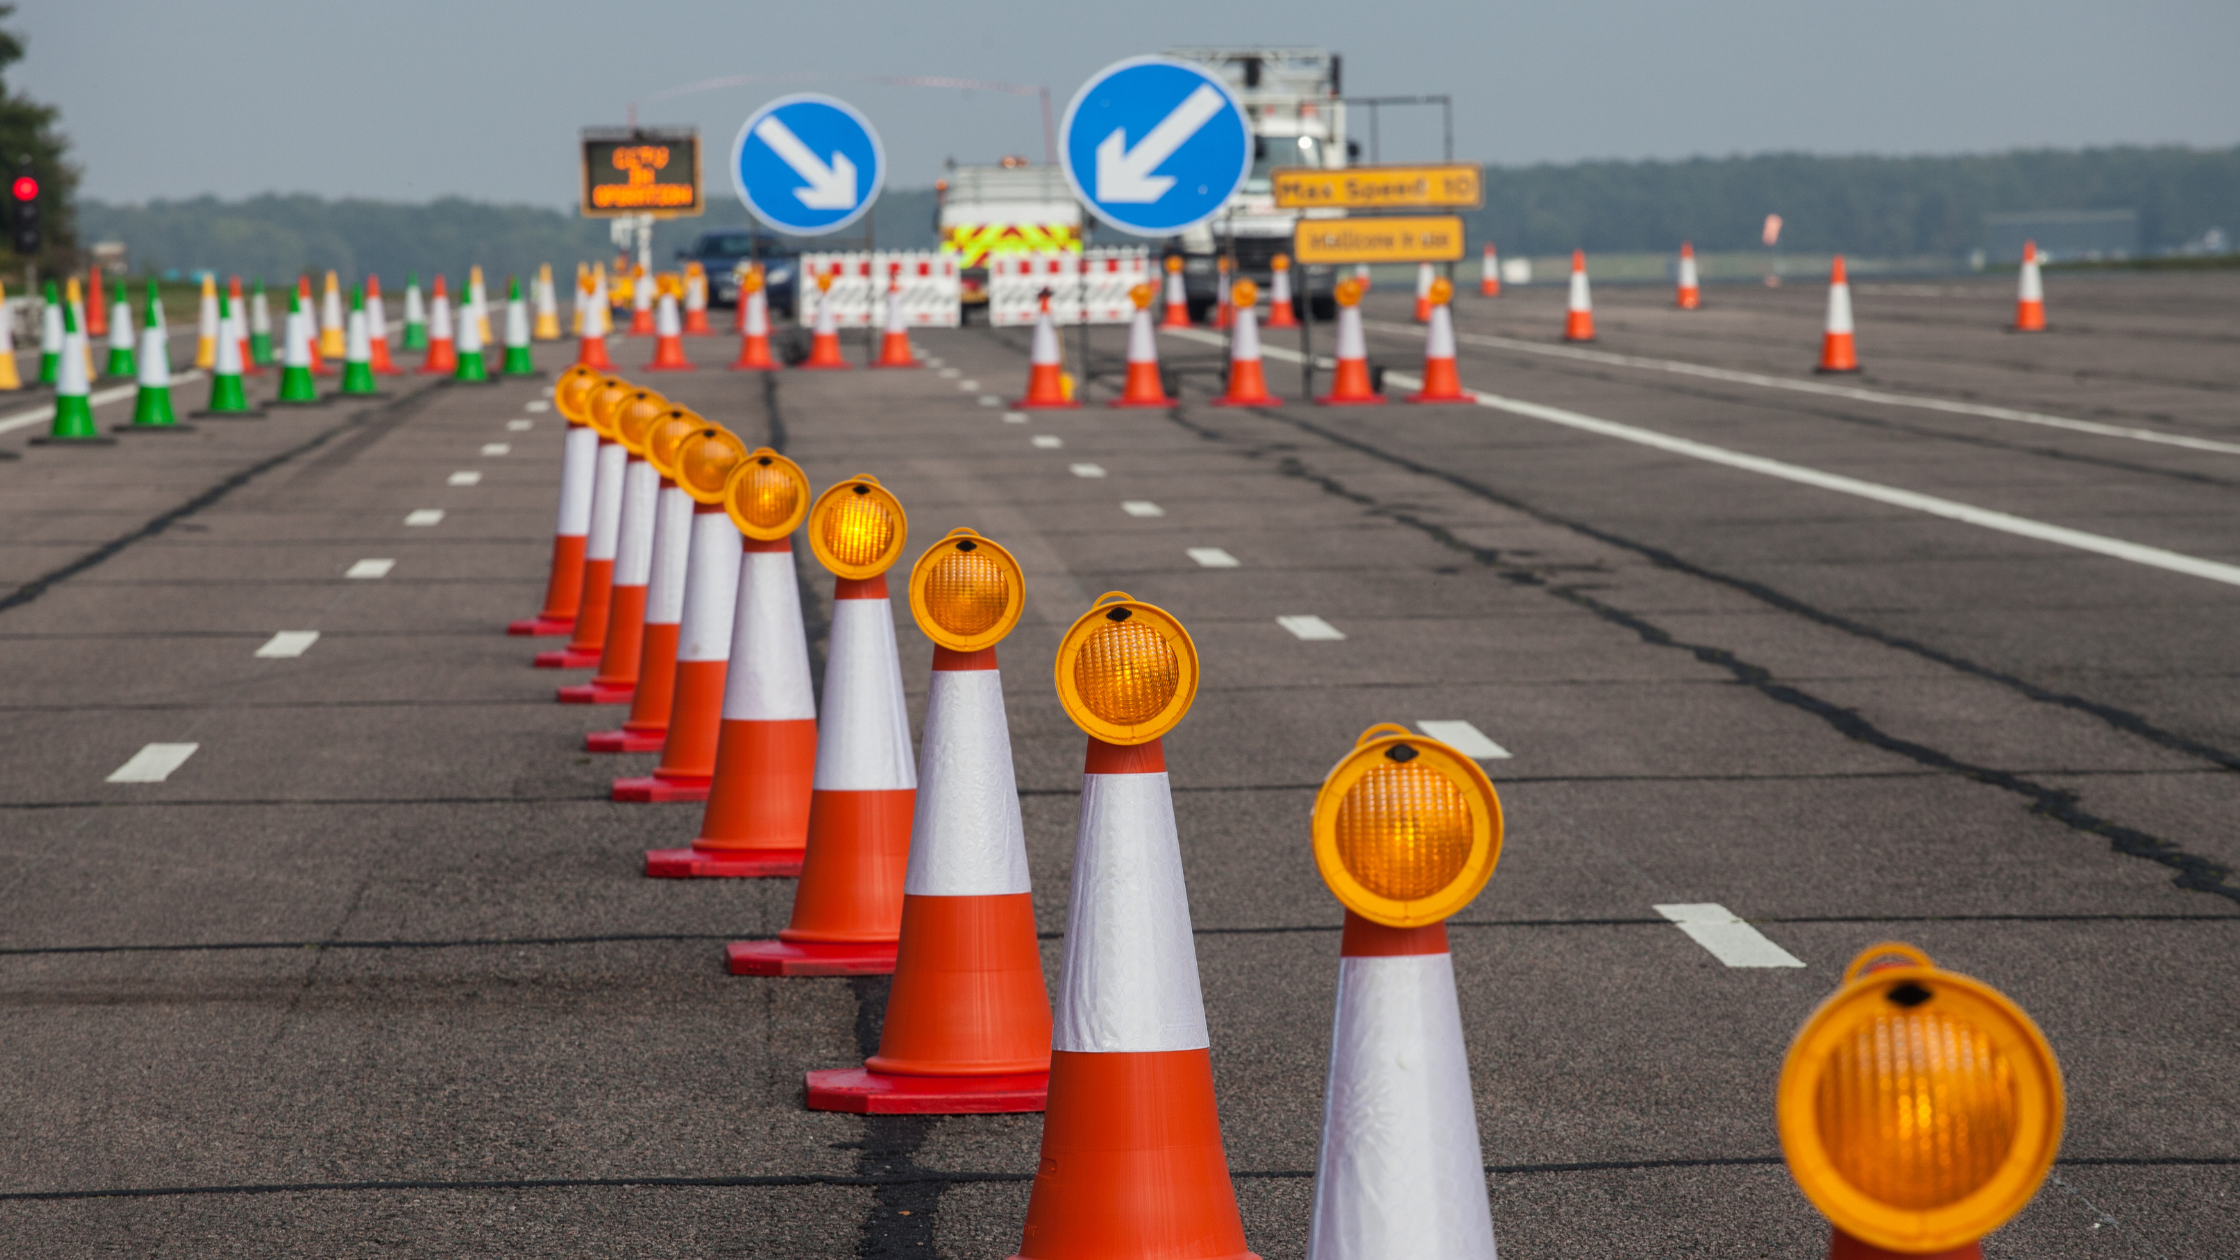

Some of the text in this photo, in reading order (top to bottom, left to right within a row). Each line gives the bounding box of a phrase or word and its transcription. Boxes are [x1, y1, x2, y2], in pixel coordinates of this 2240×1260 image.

[1279, 176, 1474, 201] Max Speed 10
